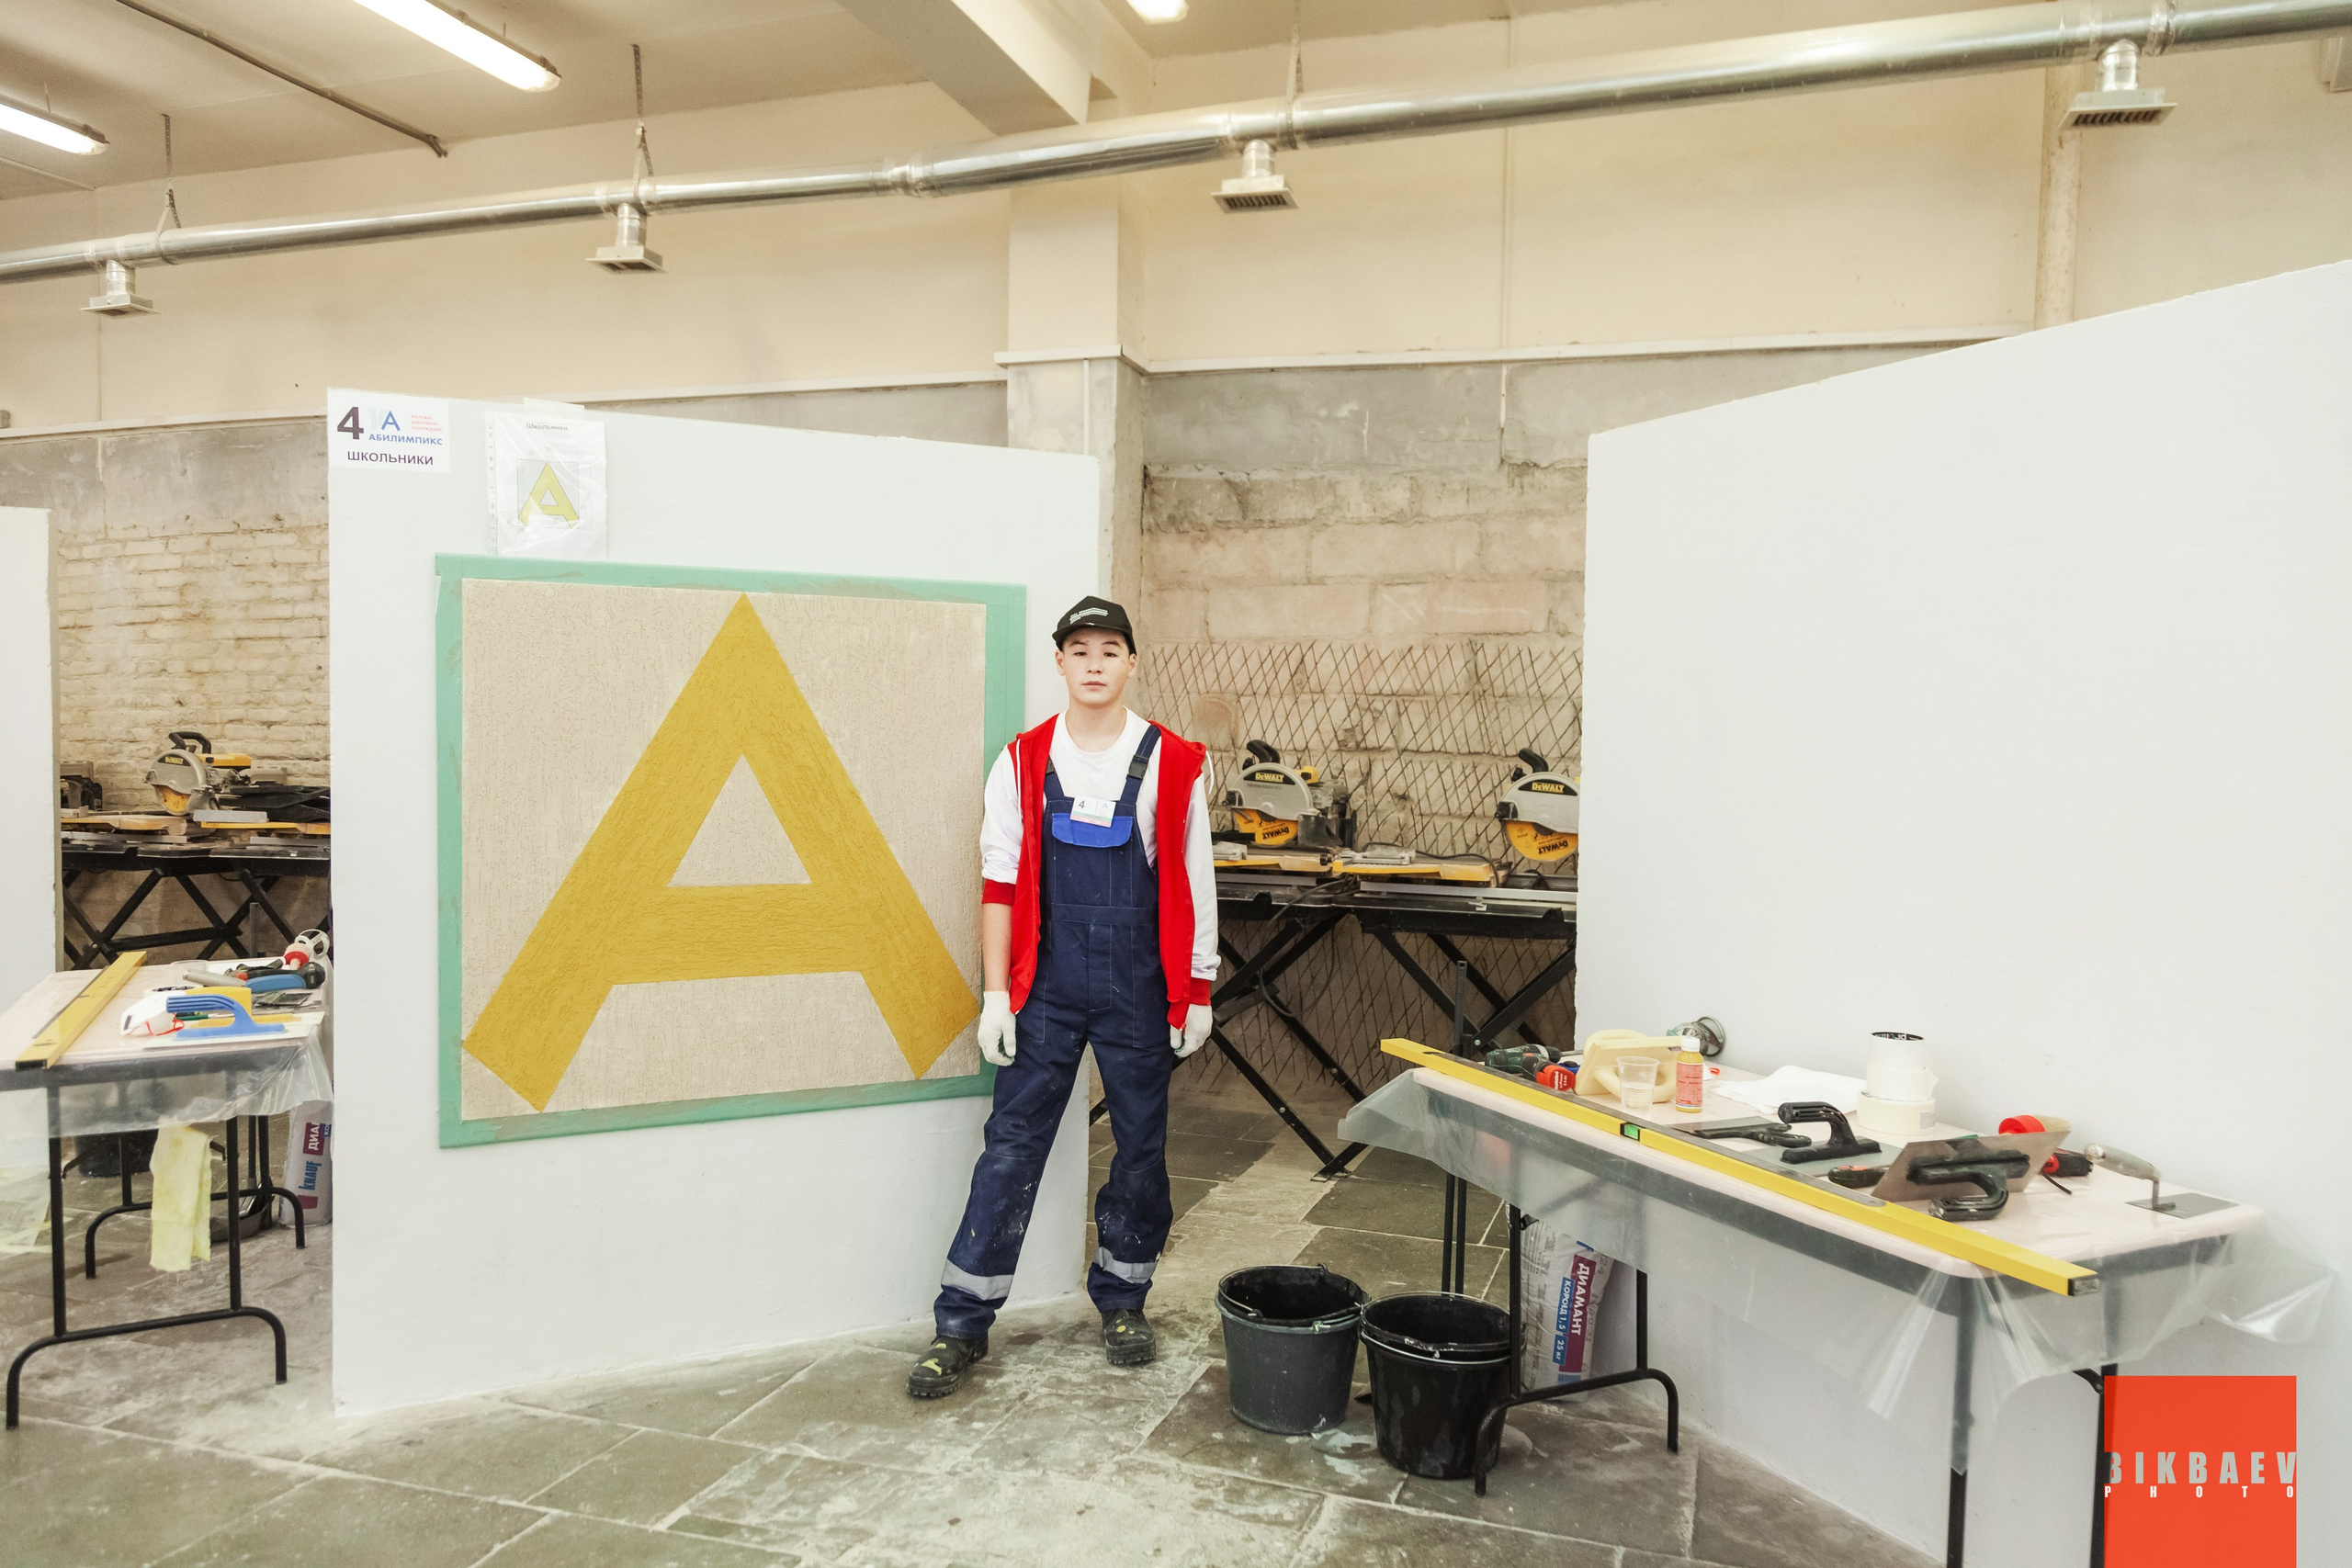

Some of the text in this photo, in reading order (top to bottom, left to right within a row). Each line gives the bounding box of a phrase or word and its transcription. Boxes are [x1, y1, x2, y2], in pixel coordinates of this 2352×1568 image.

[337, 407, 364, 440] 4
[368, 434, 443, 446] АБИЛИМПИКС
[347, 451, 434, 466] ШКОЛЬНИКИ
[1079, 800, 1085, 809] 4
[308, 1122, 320, 1151] ДИА
[1559, 1280, 1572, 1314] КОРОЕД
[1571, 1263, 1590, 1336] ДИАМАНТ
[1556, 1339, 1565, 1350] 25
